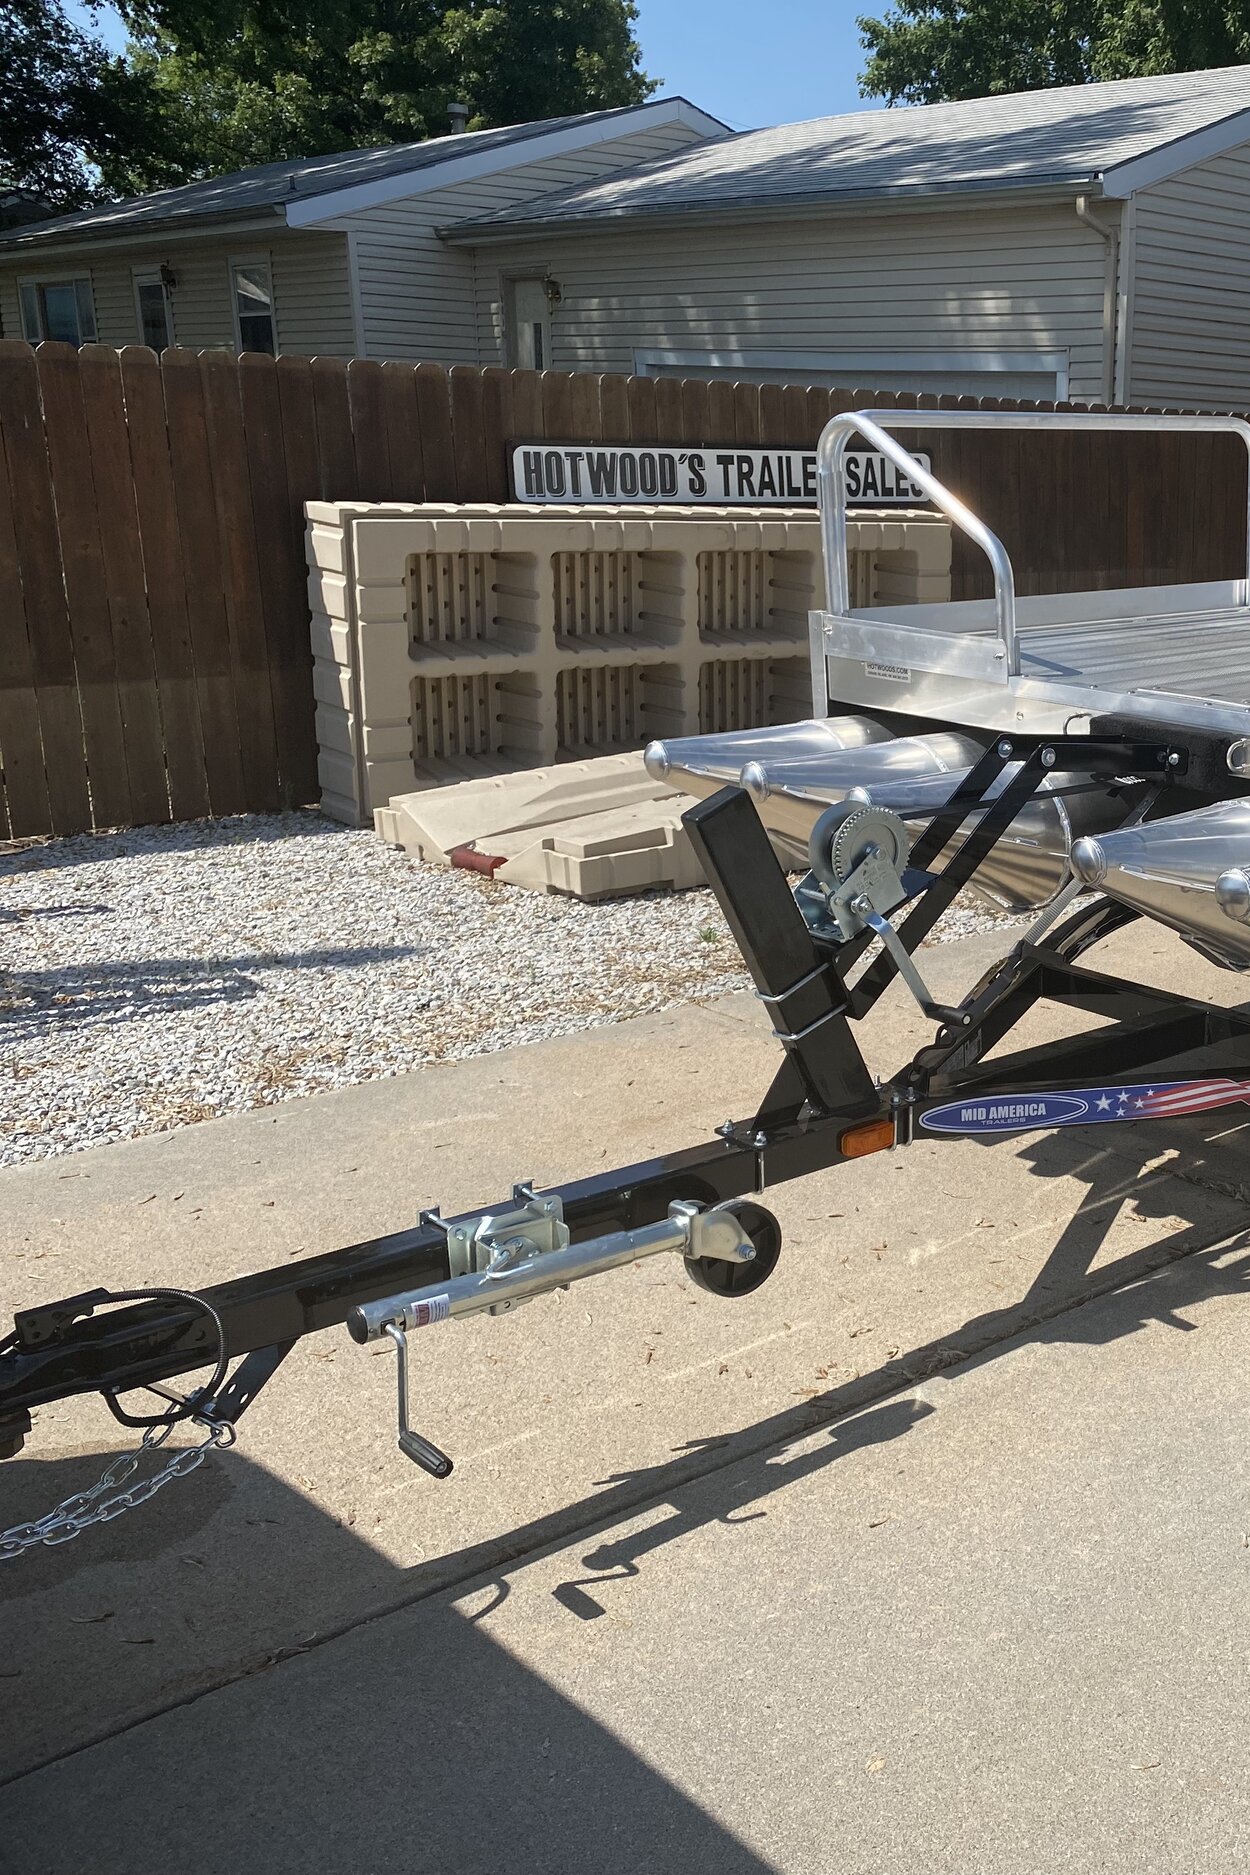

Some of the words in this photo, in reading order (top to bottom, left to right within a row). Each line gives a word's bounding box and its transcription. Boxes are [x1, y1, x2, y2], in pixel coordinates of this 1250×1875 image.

[522, 450, 707, 498] HOTWOOD'S
[716, 454, 819, 498] TRAILE
[961, 1107, 986, 1122] MID
[988, 1103, 1047, 1119] AMERICA
[980, 1117, 1027, 1126] TRAILERS
